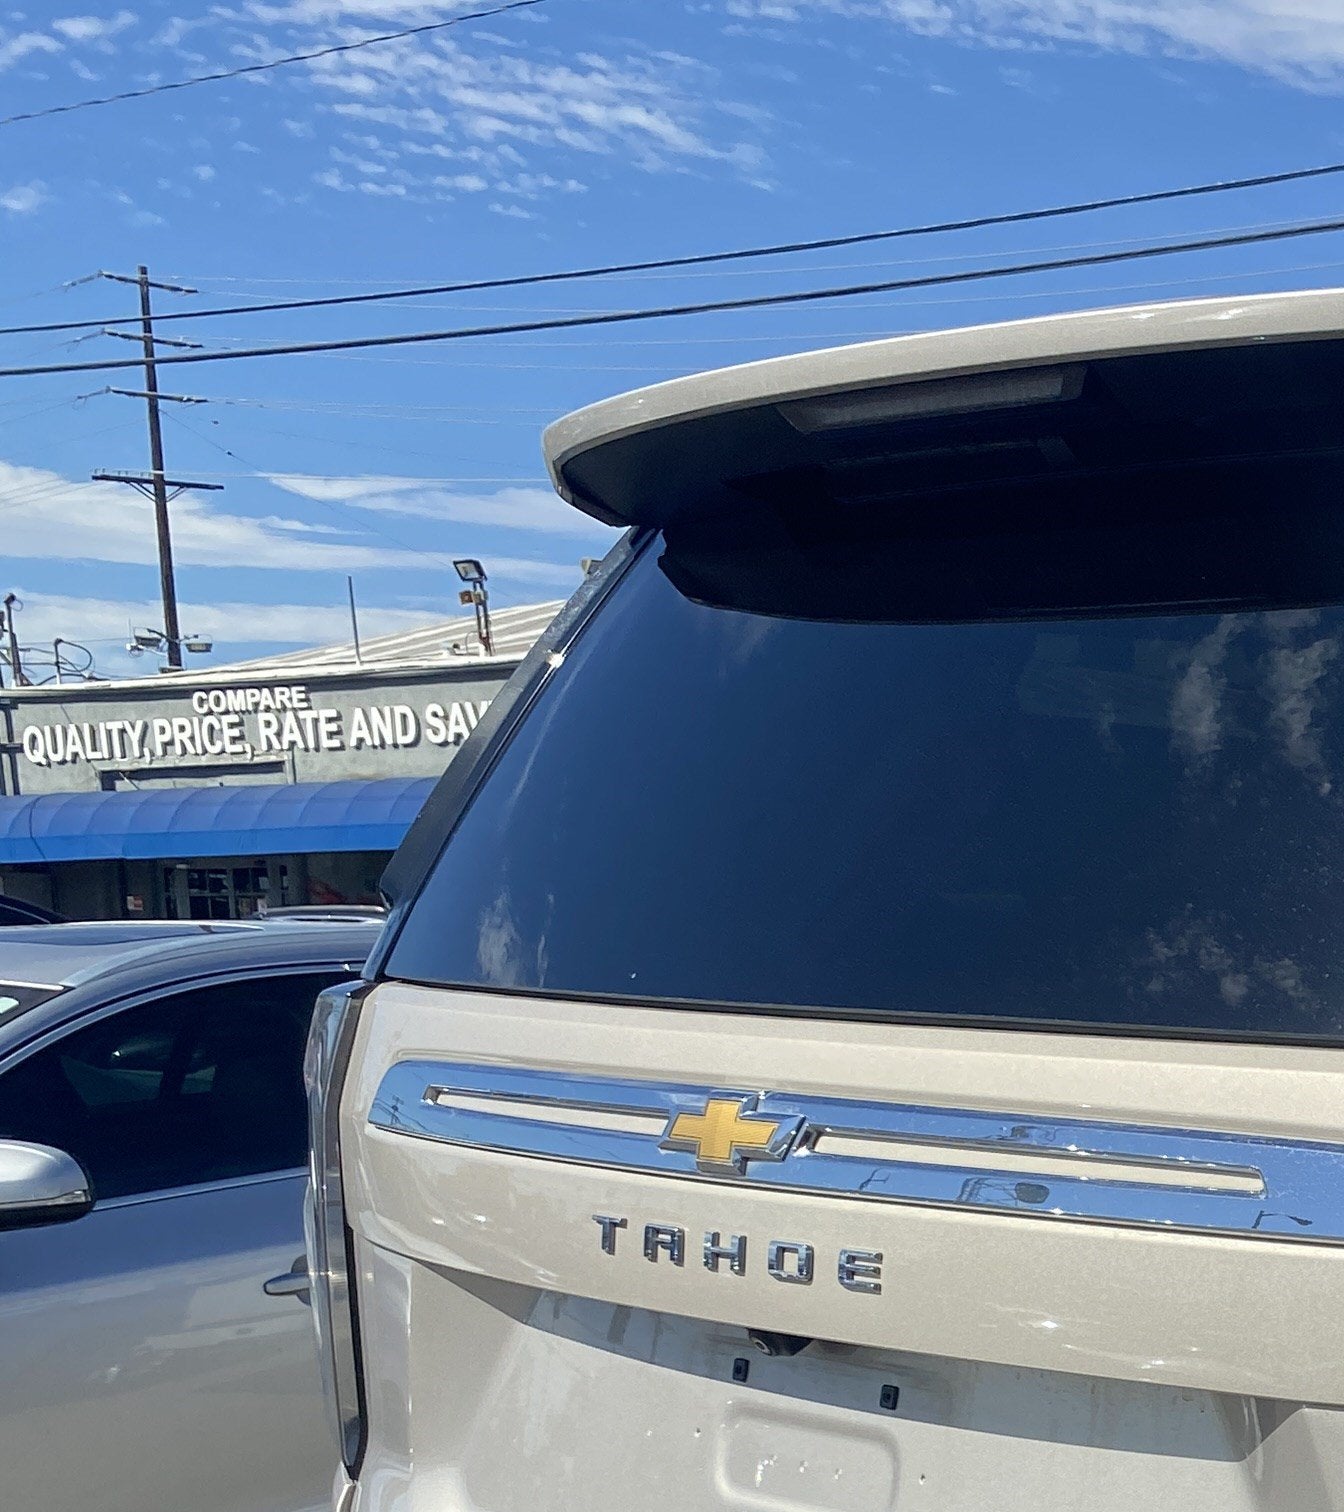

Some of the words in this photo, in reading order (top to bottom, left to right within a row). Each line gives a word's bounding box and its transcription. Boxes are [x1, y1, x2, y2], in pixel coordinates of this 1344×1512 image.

[23, 719, 152, 764] QUALITY,
[154, 715, 254, 759] PRICE,
[259, 709, 341, 751] RATE
[350, 706, 416, 746] AND
[425, 700, 493, 743] SAV
[193, 687, 308, 714] COMPARE
[592, 1213, 883, 1295] TAHOE
